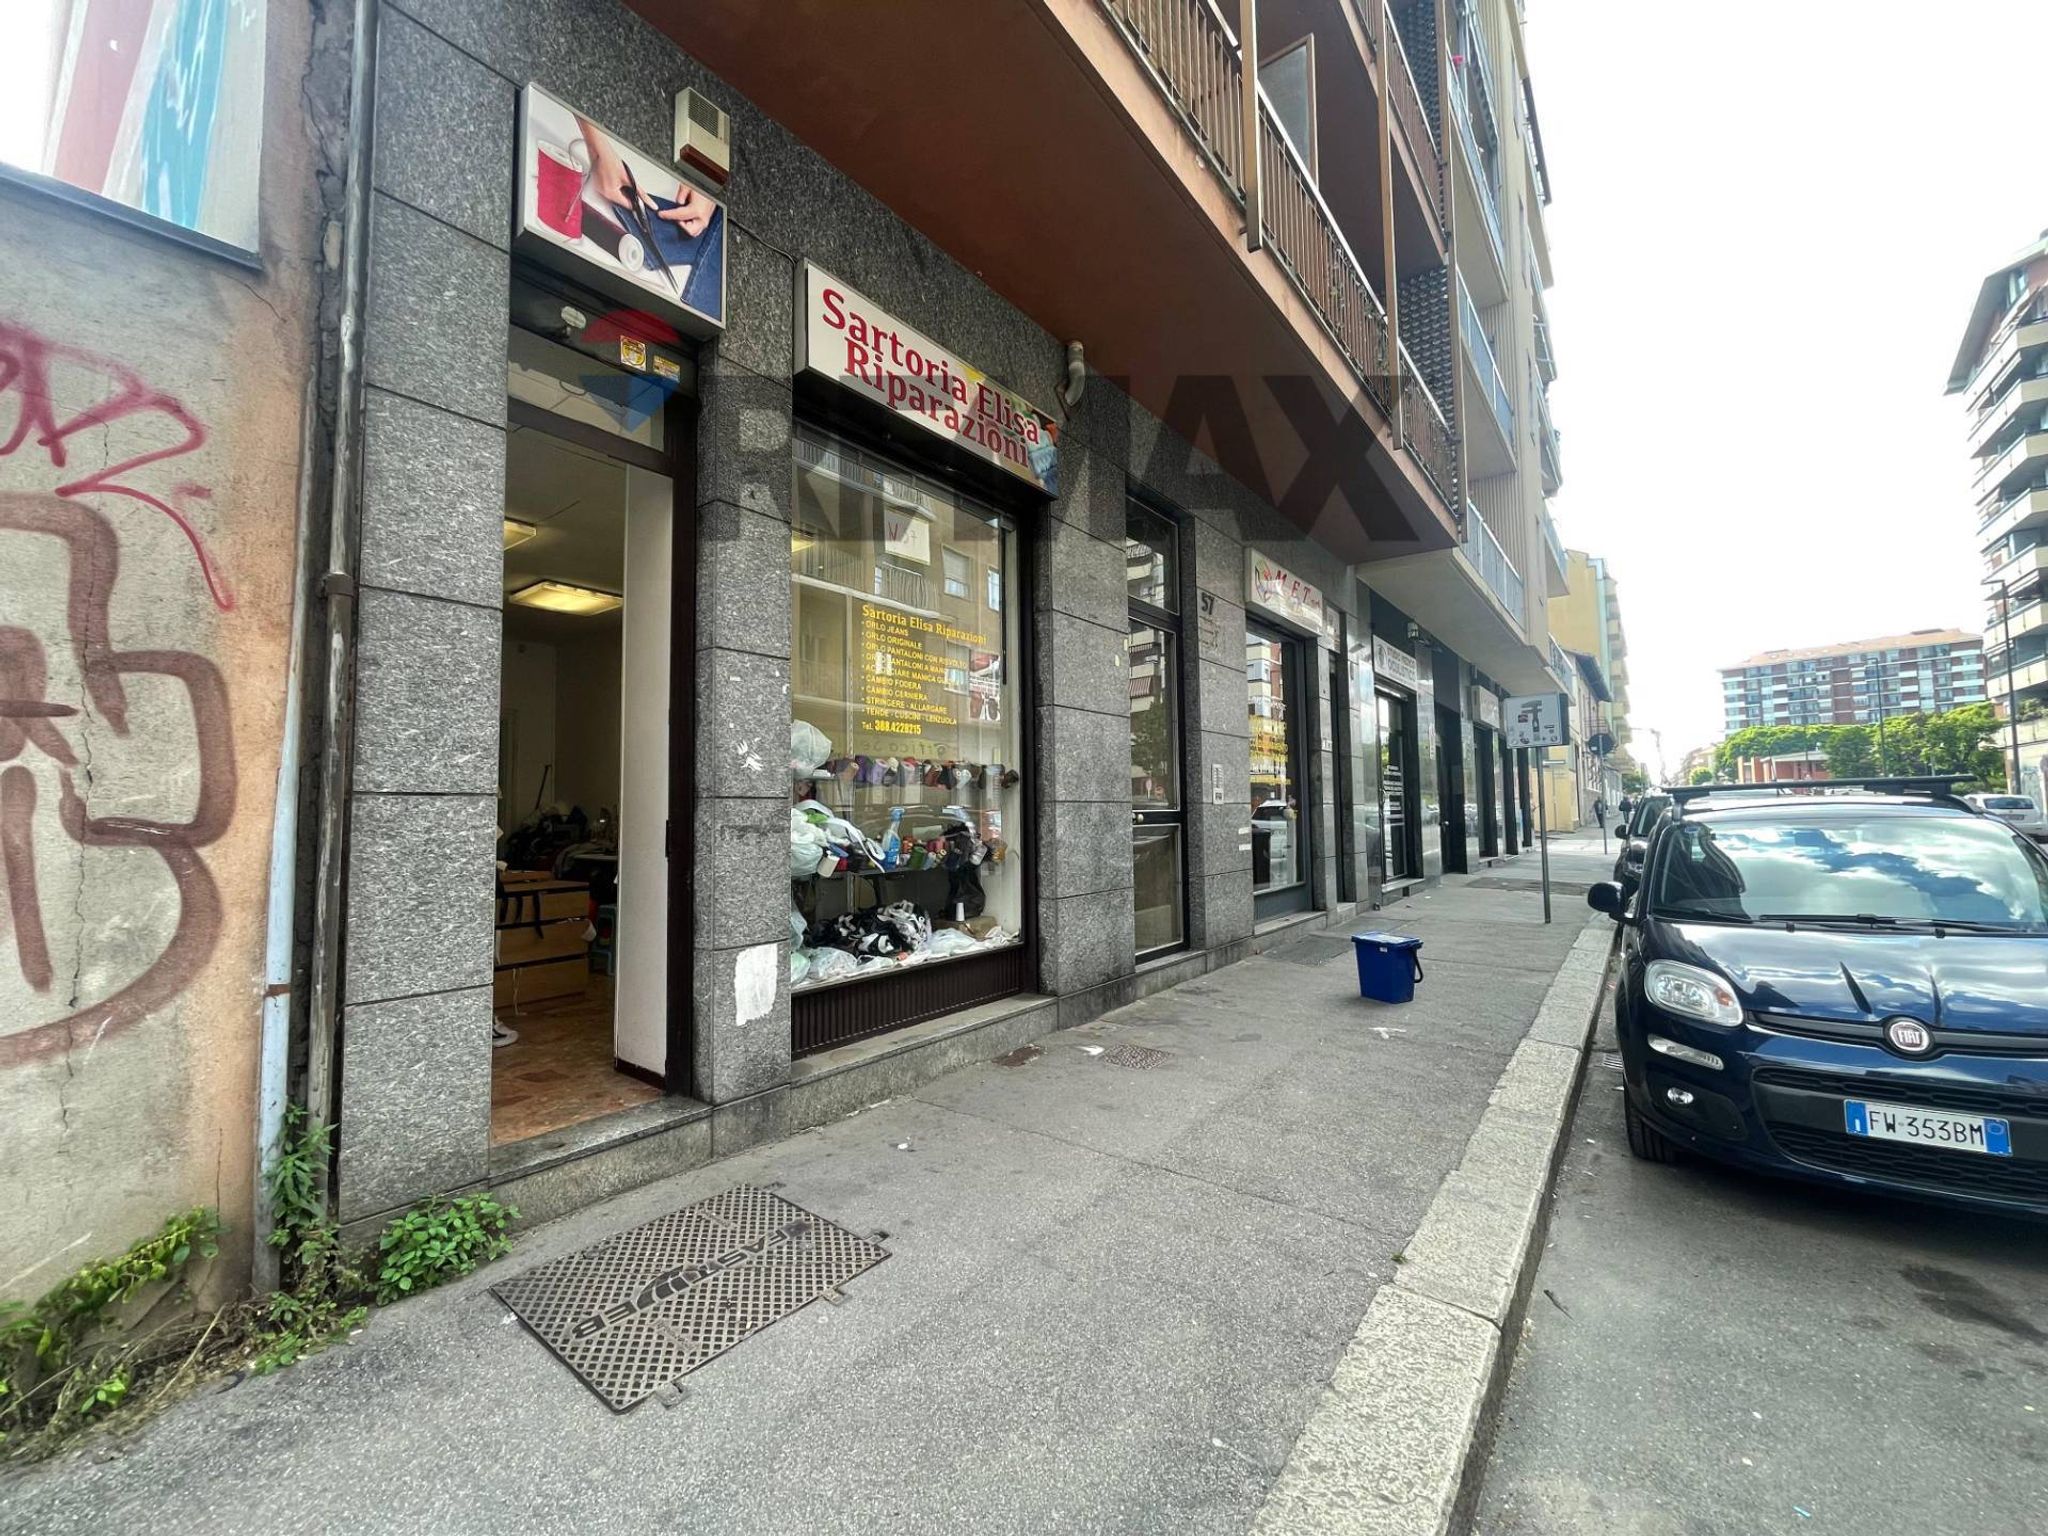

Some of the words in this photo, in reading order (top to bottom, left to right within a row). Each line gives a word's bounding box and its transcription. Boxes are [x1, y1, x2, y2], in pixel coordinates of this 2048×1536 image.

[822, 288, 968, 405] Sartoria
[977, 381, 1039, 445] Elisa
[844, 336, 1029, 468] Riparazioni
[1201, 591, 1215, 615] 57
[862, 604, 907, 626] Sartoria
[909, 616, 934, 632] Elisa
[936, 623, 987, 645] Riparazioni
[866, 620, 886, 631] ORLO
[887, 626, 909, 636] JEANS
[866, 631, 886, 642] ORLO
[887, 636, 923, 650] ORIGINALE
[866, 642, 886, 652] ORLO
[887, 646, 923, 659] PANTALONI
[866, 652, 886, 663] ORO
[866, 663, 910, 677] ACOCIARE
[866, 674, 893, 685] CAMBIO
[866, 685, 893, 696] CAMBIO
[866, 696, 905, 709] STRINGERE
[866, 707, 889, 717] TENDE
[894, 710, 920, 720] CUSCINI
[1897, 1029, 1921, 1044] FIAT
[1869, 1110, 1896, 1133] FW
[1906, 1116, 1984, 1146] 353BM
